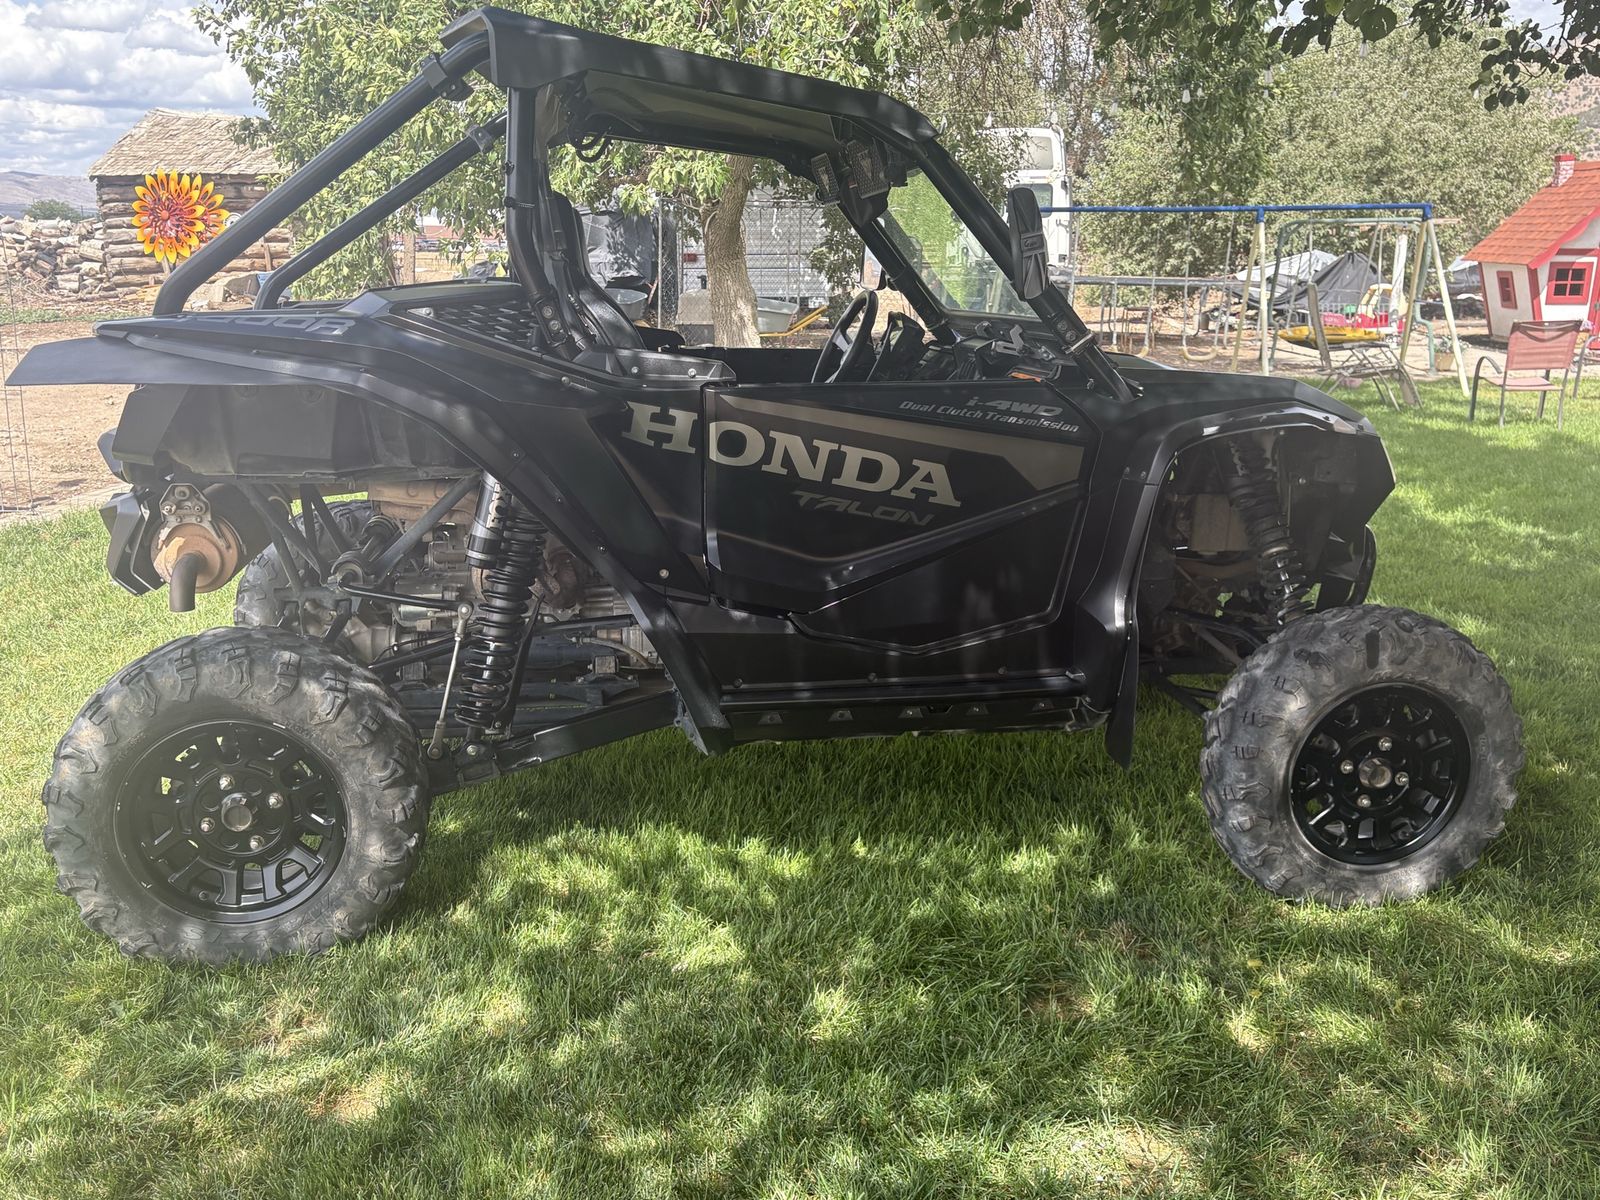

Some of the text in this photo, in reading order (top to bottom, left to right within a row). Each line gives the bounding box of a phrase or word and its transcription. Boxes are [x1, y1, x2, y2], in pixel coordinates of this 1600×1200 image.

[899, 400, 1080, 433] Dual Clutch Transmission
[965, 396, 1063, 416] i-4WD
[621, 400, 961, 507] HONDA
[789, 490, 936, 526] TALON
